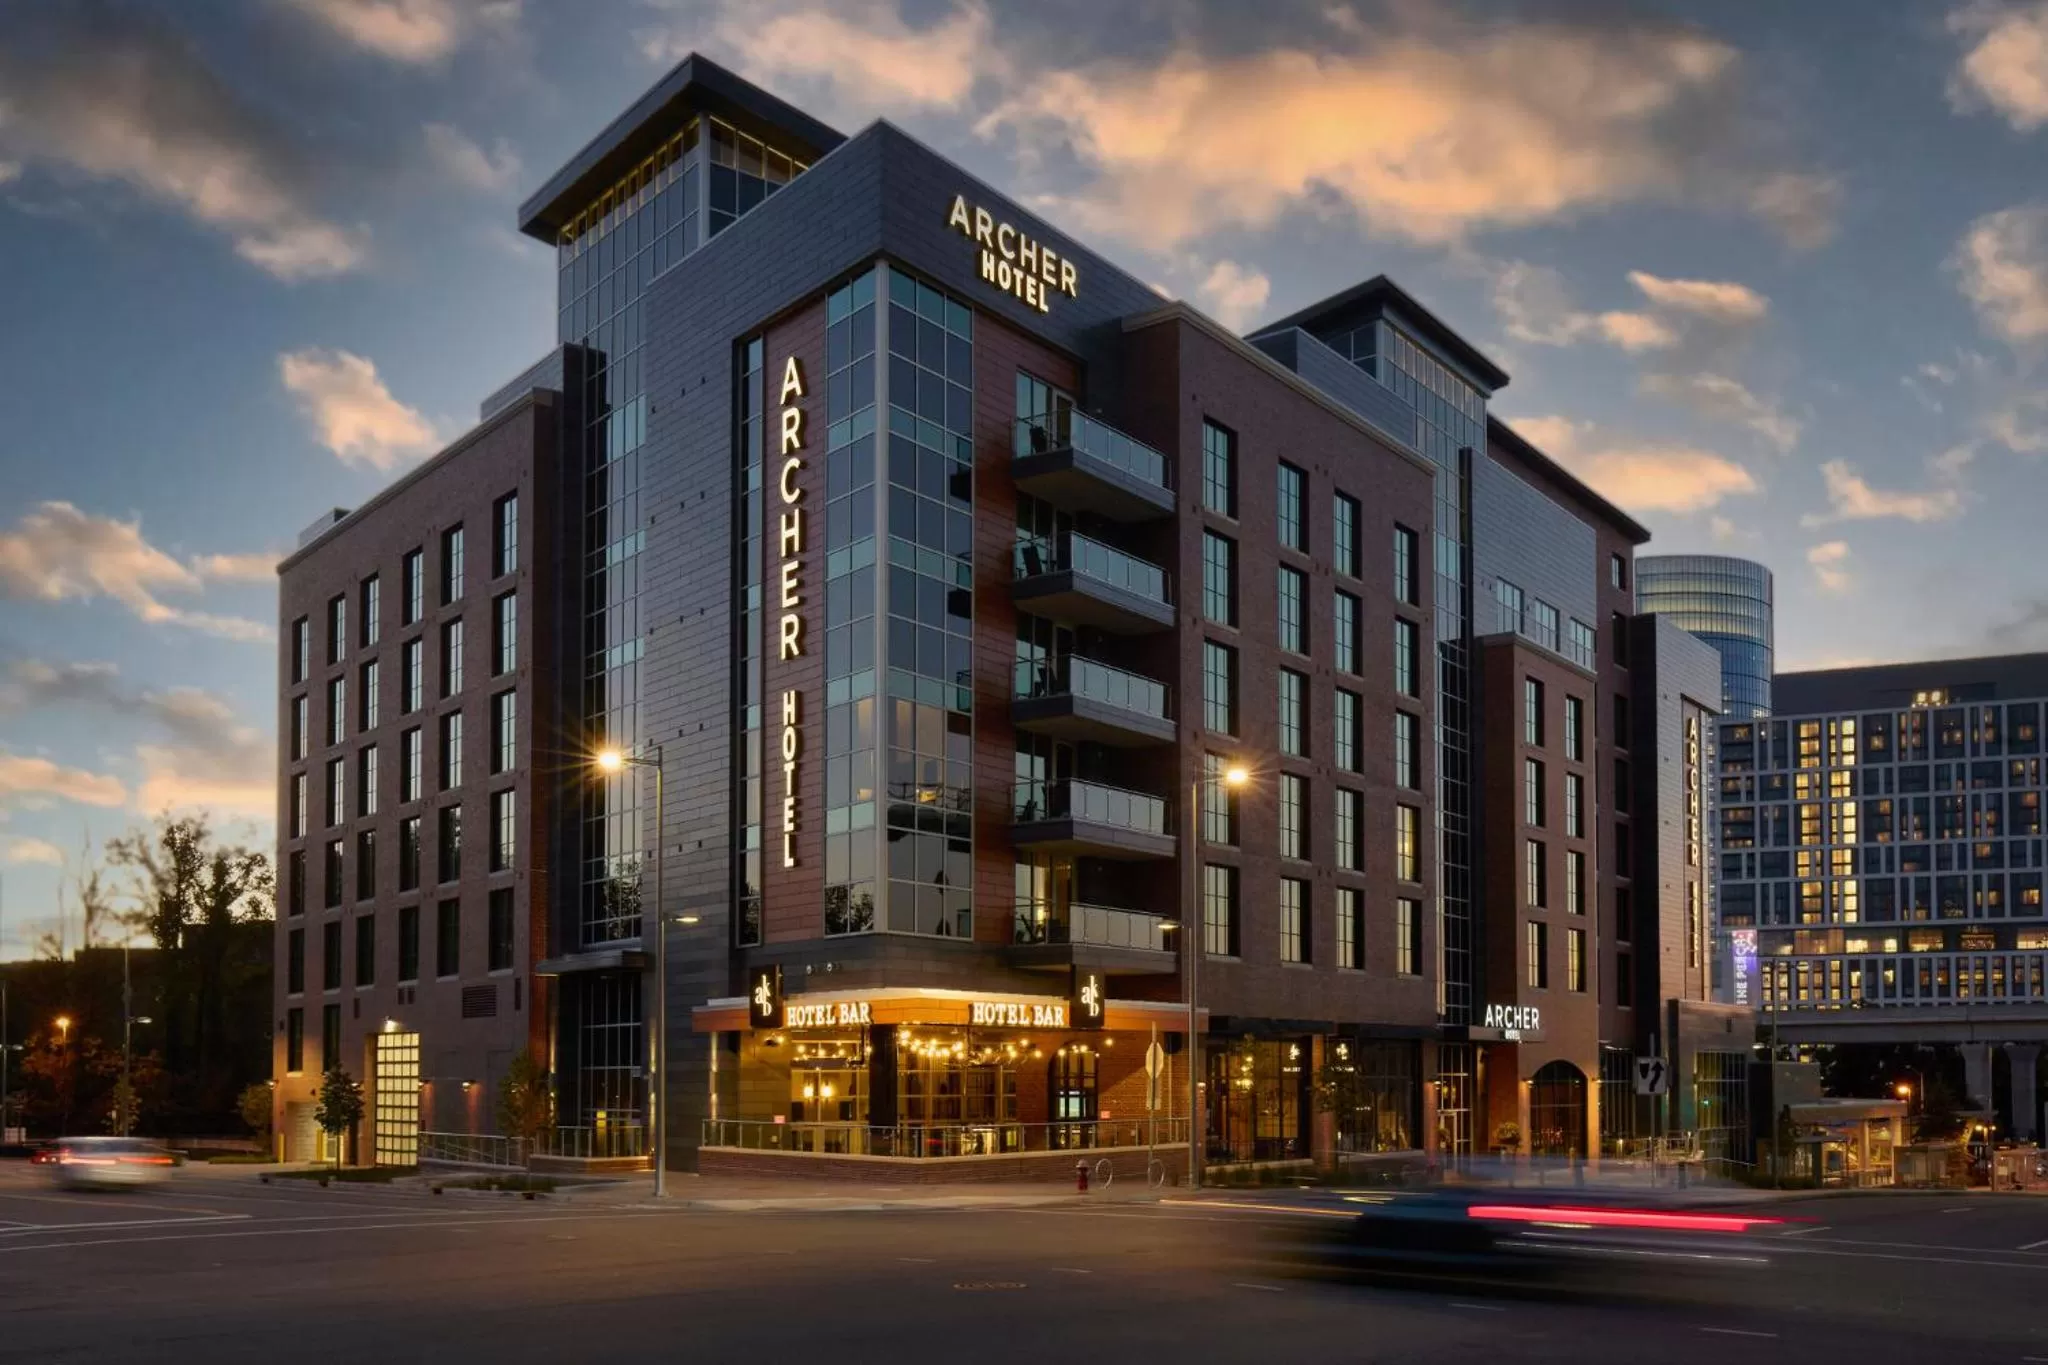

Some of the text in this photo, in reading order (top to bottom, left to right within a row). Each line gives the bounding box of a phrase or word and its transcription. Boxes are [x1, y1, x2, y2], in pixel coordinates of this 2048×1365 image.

[950, 194, 1077, 297] ARCHER
[982, 249, 1049, 312] HOTEL
[780, 356, 802, 868] ARCHER HOTEL
[1689, 717, 1699, 867] ARCHER
[787, 1002, 870, 1026] HOTEL BAR
[972, 1001, 1065, 1025] HOTEL BAR
[1485, 1004, 1540, 1030] ARCHER
